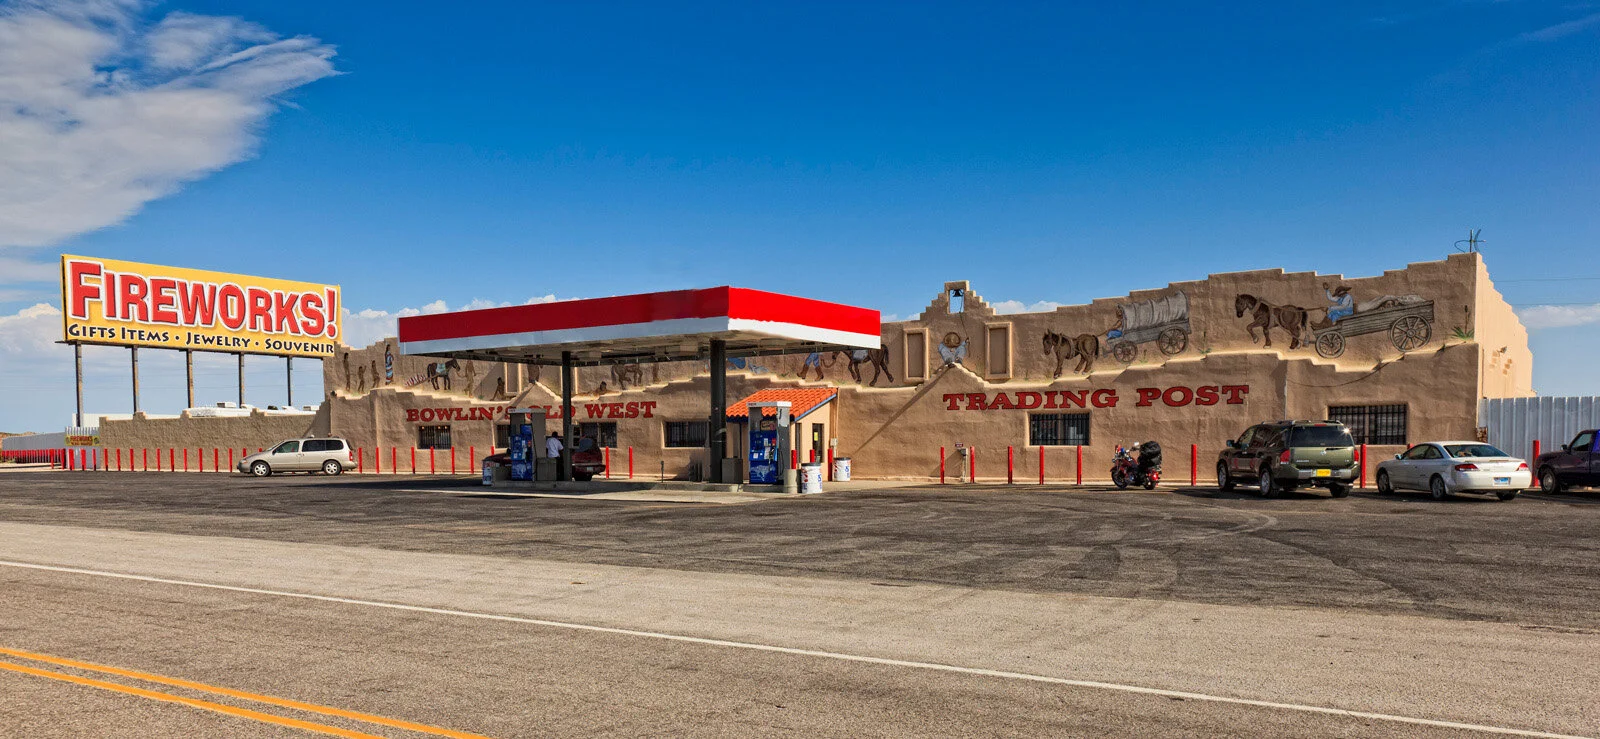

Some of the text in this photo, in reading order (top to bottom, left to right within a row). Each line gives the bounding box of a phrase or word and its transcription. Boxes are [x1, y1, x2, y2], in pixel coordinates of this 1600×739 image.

[68, 260, 336, 338] FIREWORKS!
[68, 323, 334, 353] GIFTS ITEMS JEWELRY SOUVENIR
[585, 401, 657, 419] WEST
[943, 385, 1249, 411] TRADING POST
